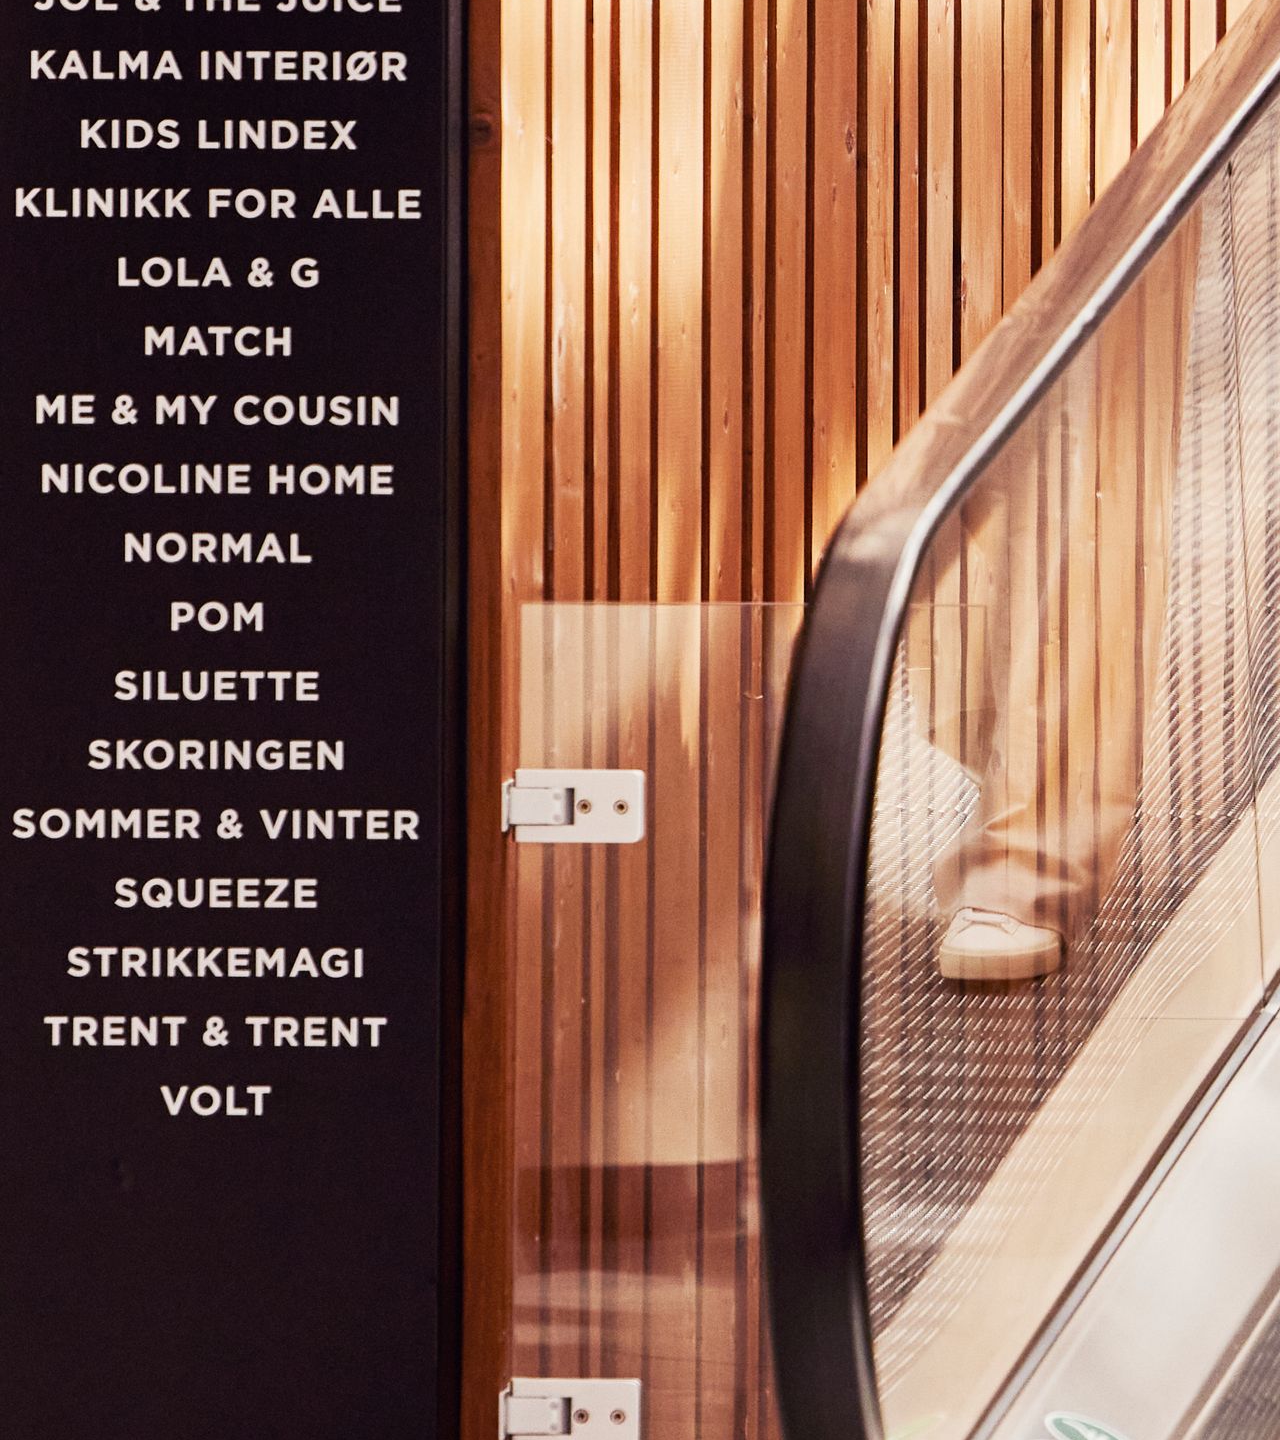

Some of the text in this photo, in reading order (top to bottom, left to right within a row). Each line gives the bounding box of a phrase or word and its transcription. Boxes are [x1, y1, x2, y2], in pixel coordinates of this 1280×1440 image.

[30, 49, 407, 82] KALMA INTERIØR
[80, 118, 357, 150] KIDS LINDEX
[15, 187, 422, 220] KLINIKK FOR ALLE
[117, 256, 319, 288] LOLA & G
[144, 325, 292, 357] MATCH
[35, 394, 399, 426] ME & MY COUSIN
[41, 463, 394, 496] NICOLINE HOME
[124, 532, 313, 564] NORMAL
[170, 601, 264, 632] POM
[114, 670, 320, 702] SILUETTE
[87, 739, 344, 771] SKORINGEN
[12, 808, 420, 840] SOMMER & VINTER
[114, 877, 318, 909] SQUEEZE
[67, 946, 364, 979] STRIKKEMAGI
[43, 1015, 388, 1048] TRENT & TRENT
[160, 1085, 272, 1117] VOLT
